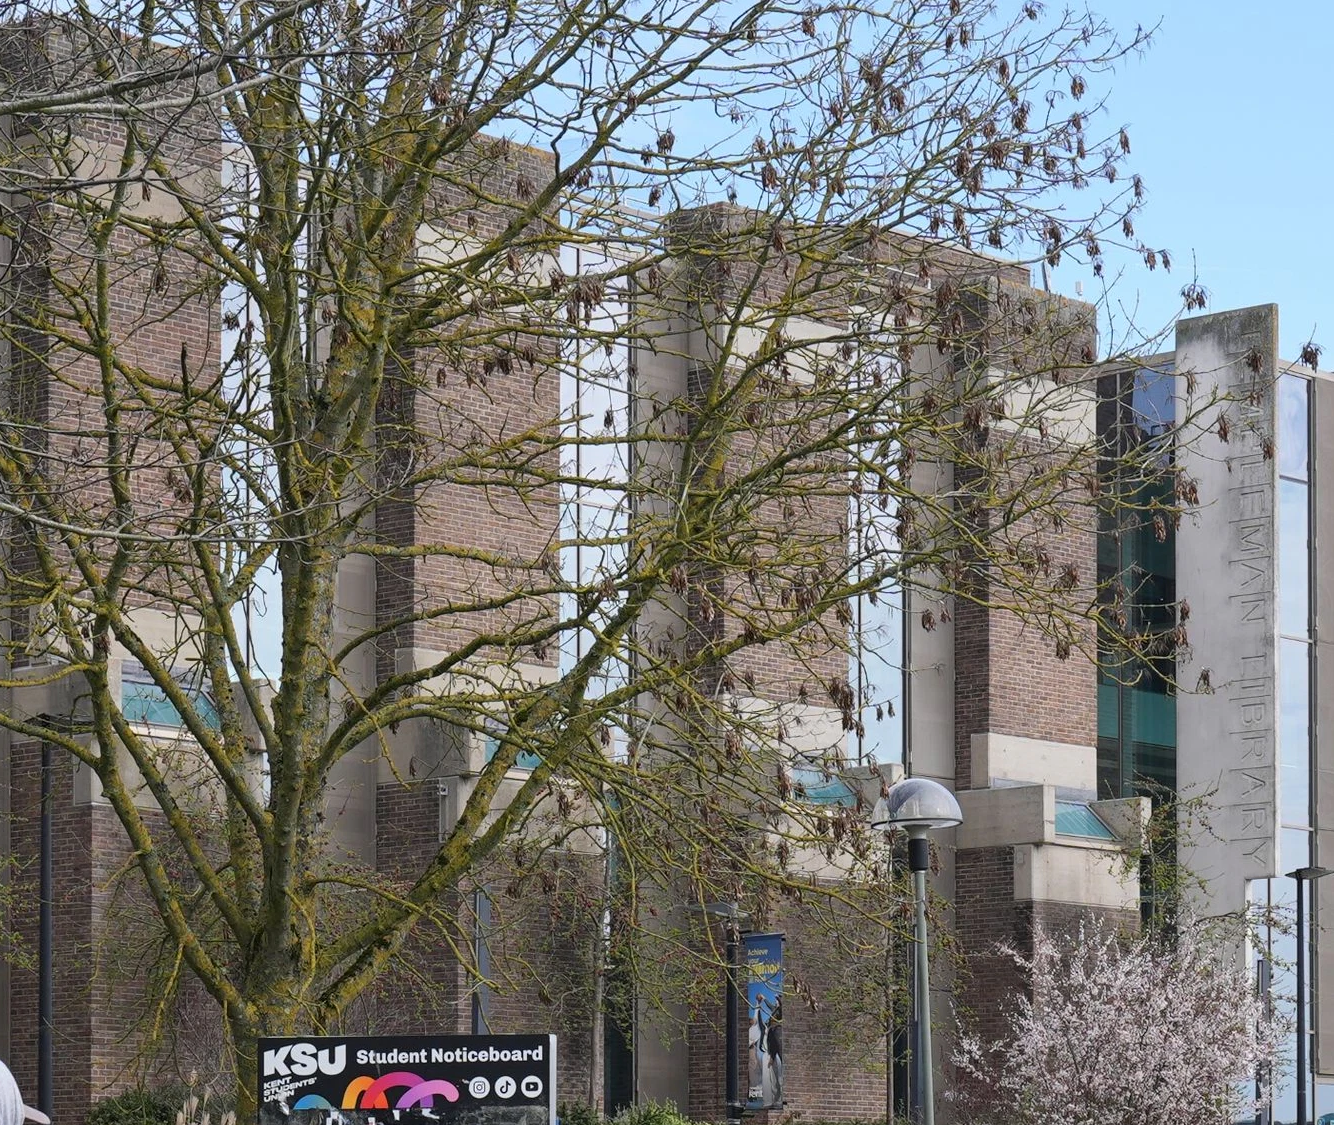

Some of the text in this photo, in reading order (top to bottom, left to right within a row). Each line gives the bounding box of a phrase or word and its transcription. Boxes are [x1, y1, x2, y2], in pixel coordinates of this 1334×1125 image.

[1240, 655, 1266, 866] LIBRARY
[263, 1042, 543, 1076] KSU Student Noticeboard
[263, 1076, 292, 1089] KENT
